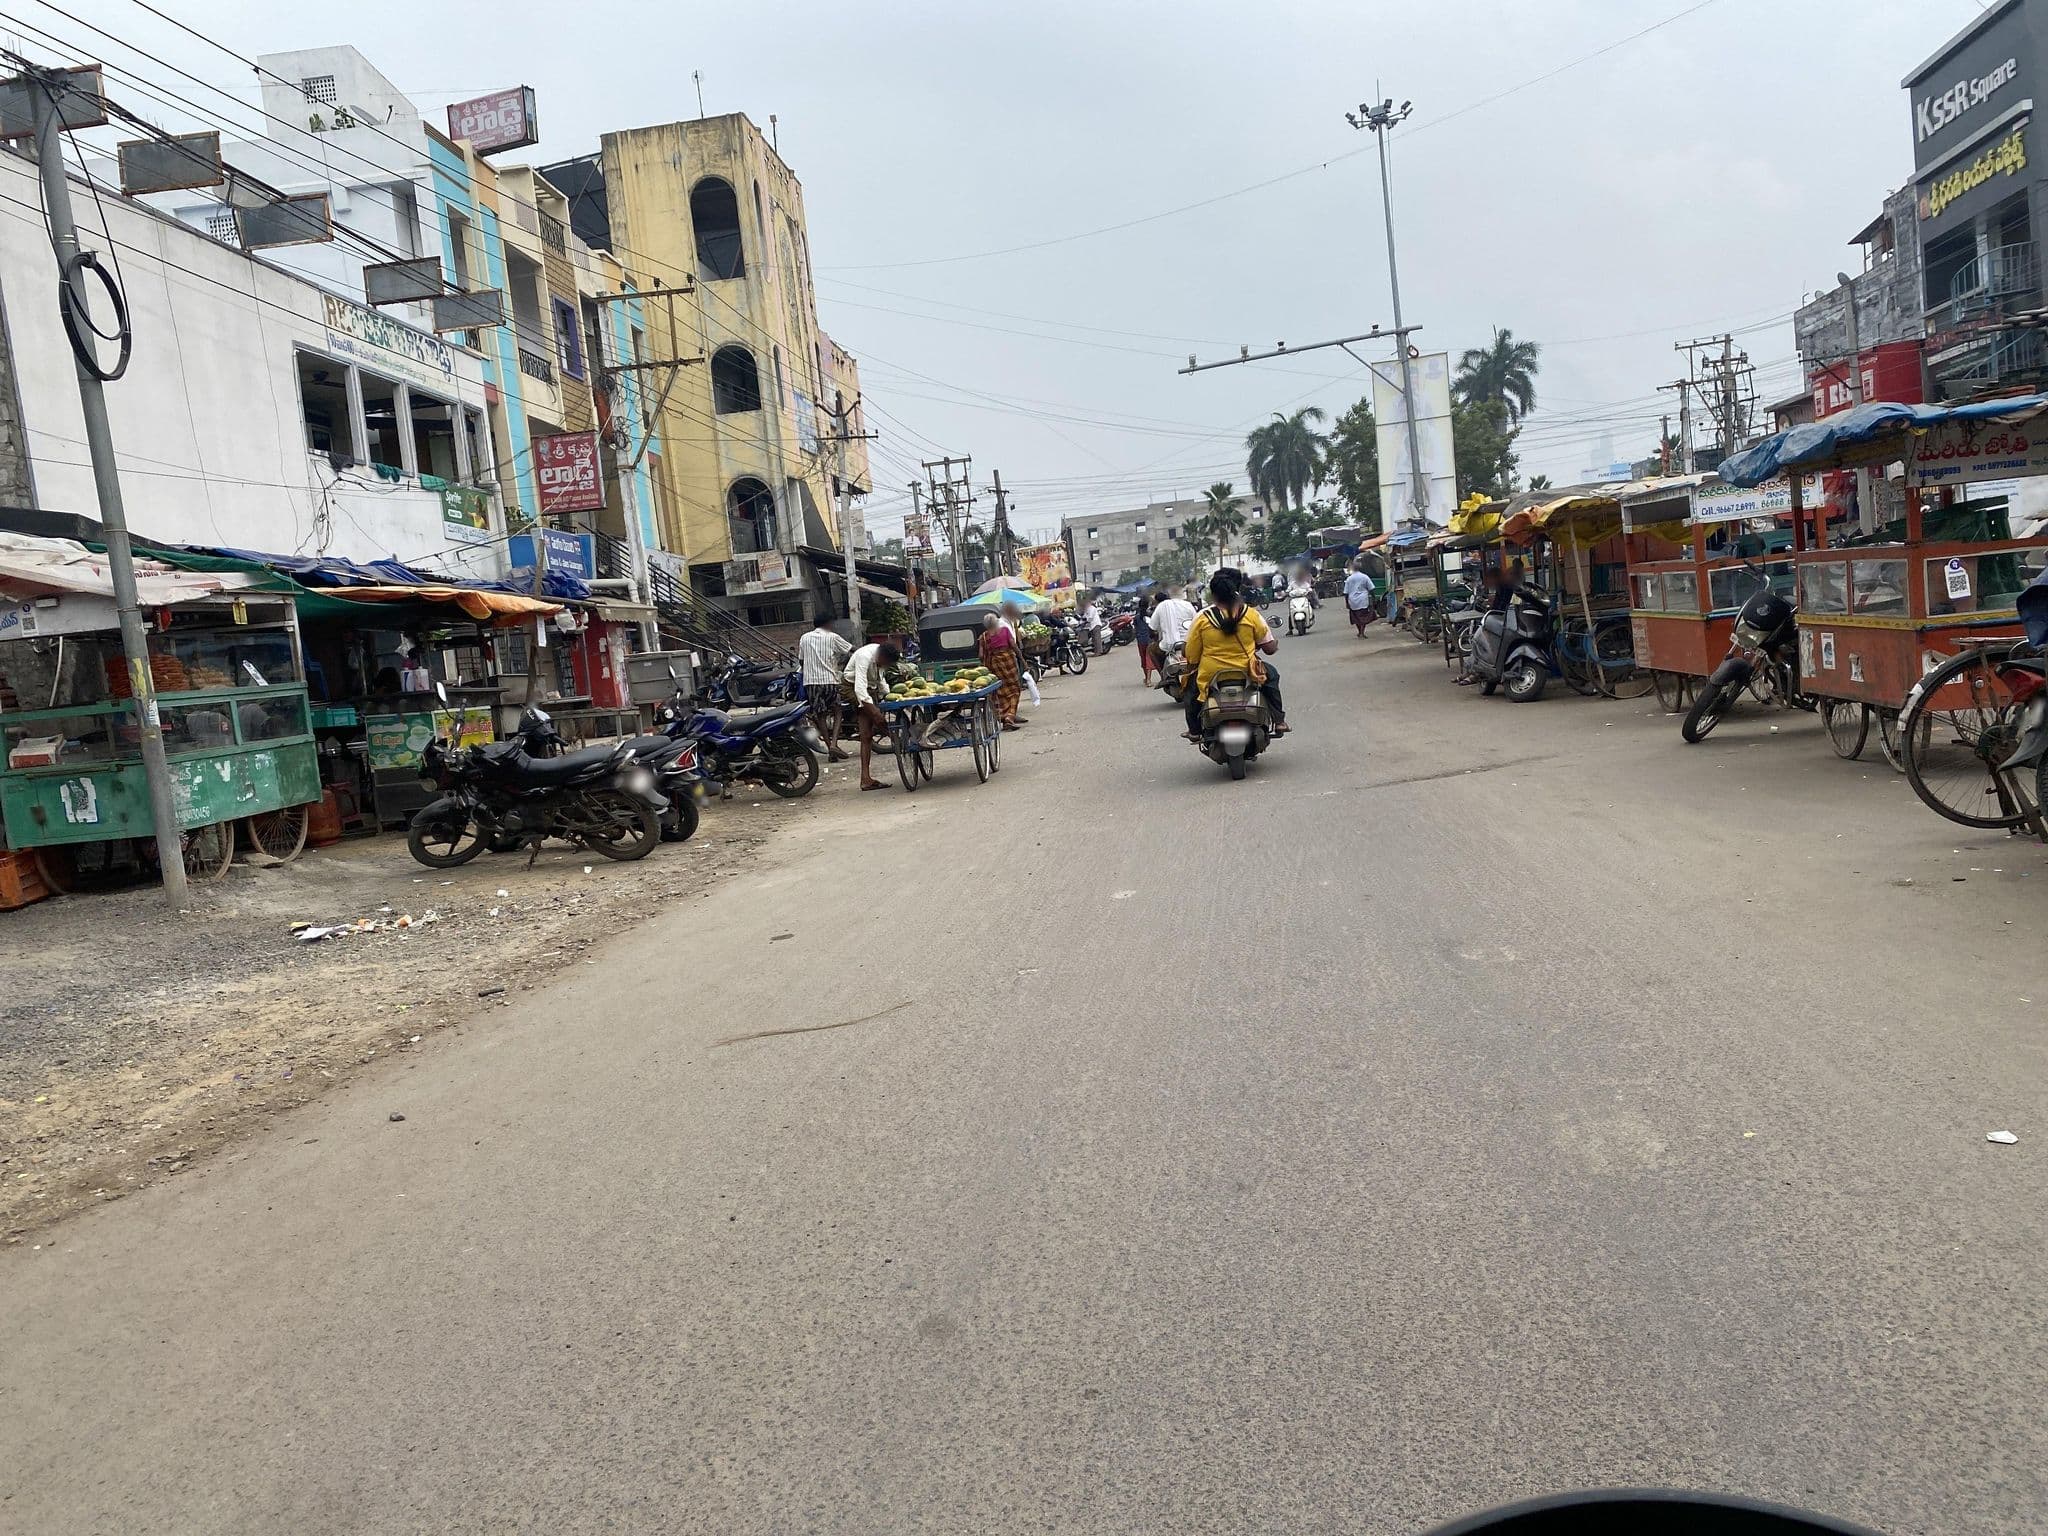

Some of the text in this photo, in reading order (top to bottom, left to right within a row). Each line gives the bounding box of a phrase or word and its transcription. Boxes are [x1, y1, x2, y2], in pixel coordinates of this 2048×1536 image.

[1969, 58, 2017, 106] Square
[552, 444, 566, 460] శ్రీ
[445, 490, 462, 506] Sprite
